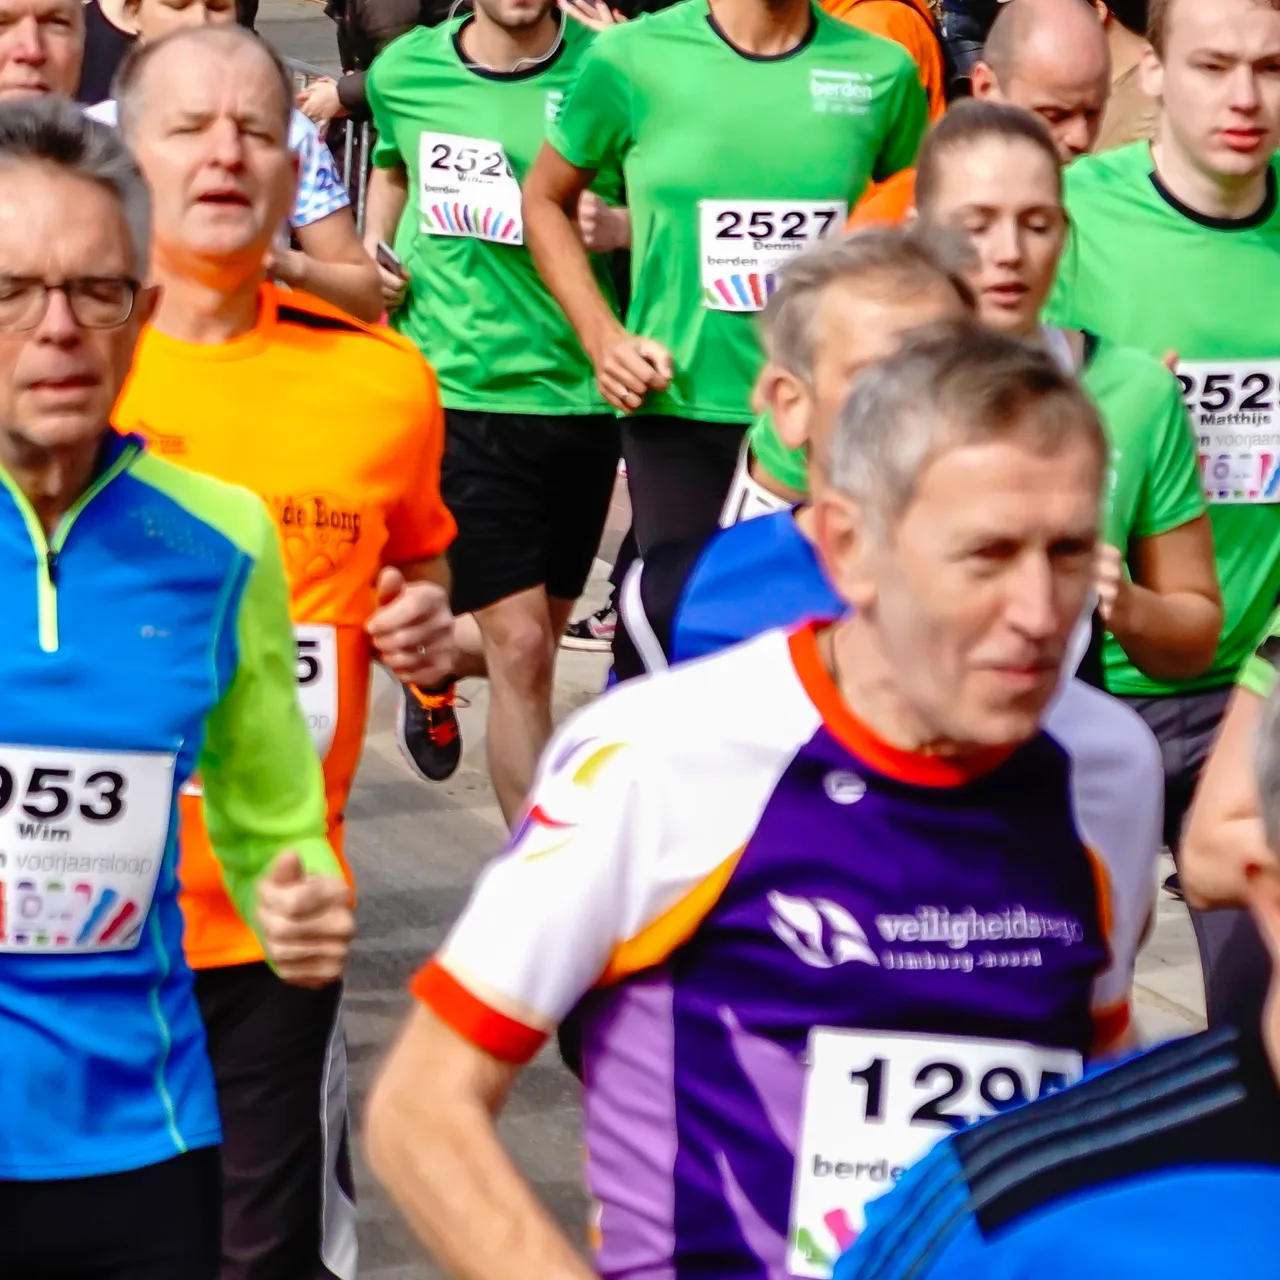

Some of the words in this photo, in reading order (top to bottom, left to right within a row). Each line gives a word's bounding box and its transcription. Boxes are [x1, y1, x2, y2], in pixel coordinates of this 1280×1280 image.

[715, 210, 839, 241] 2527
[752, 240, 804, 251] Dennis
[707, 255, 759, 266] berden
[1175, 373, 1280, 413] 252
[1200, 412, 1272, 427] Matthijs
[17, 821, 72, 844] Wim
[16, 851, 154, 876] voorjaarsloop
